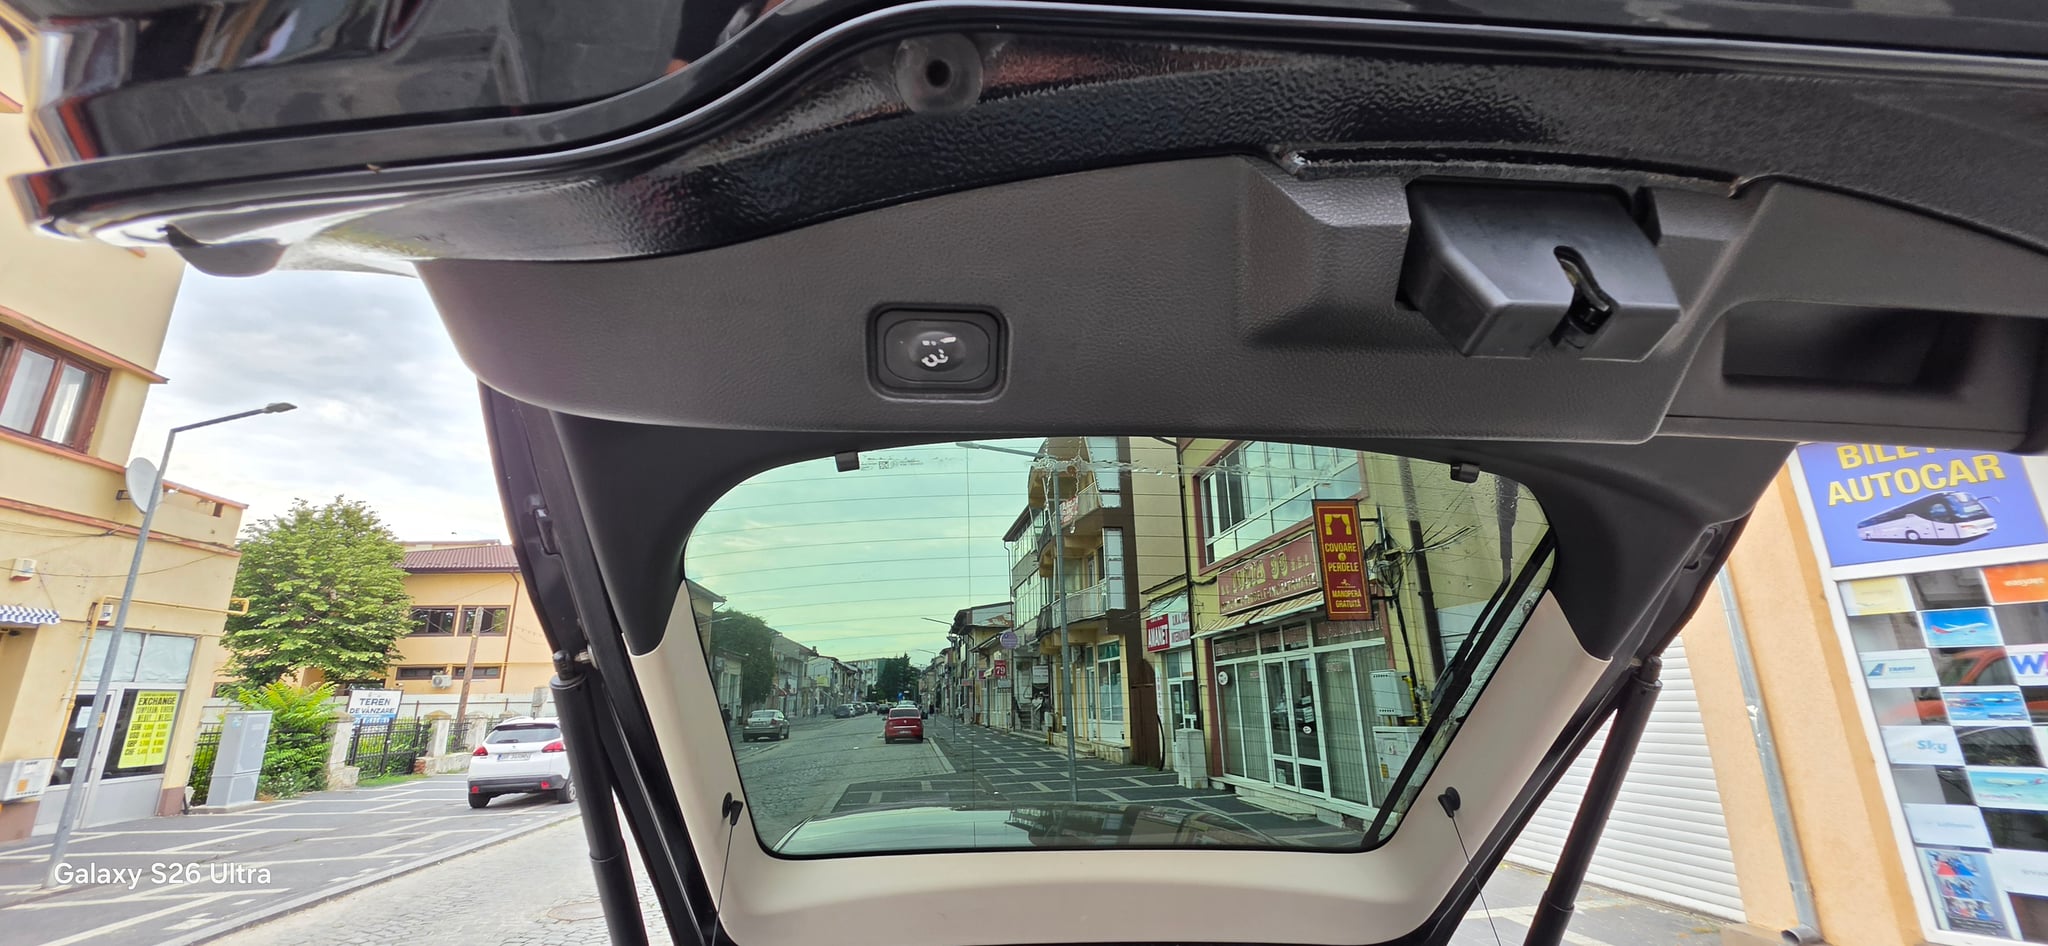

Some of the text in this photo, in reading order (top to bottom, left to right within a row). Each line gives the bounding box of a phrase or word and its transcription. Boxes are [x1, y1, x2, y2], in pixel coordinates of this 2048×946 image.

[1828, 454, 2006, 506] AUTOCAR
[1324, 542, 1357, 552] COVOARE
[1328, 562, 1359, 572] PERDELE
[1148, 624, 1168, 648] AMANET
[995, 666, 1005, 675] 79
[138, 697, 176, 706] EXCHANGE
